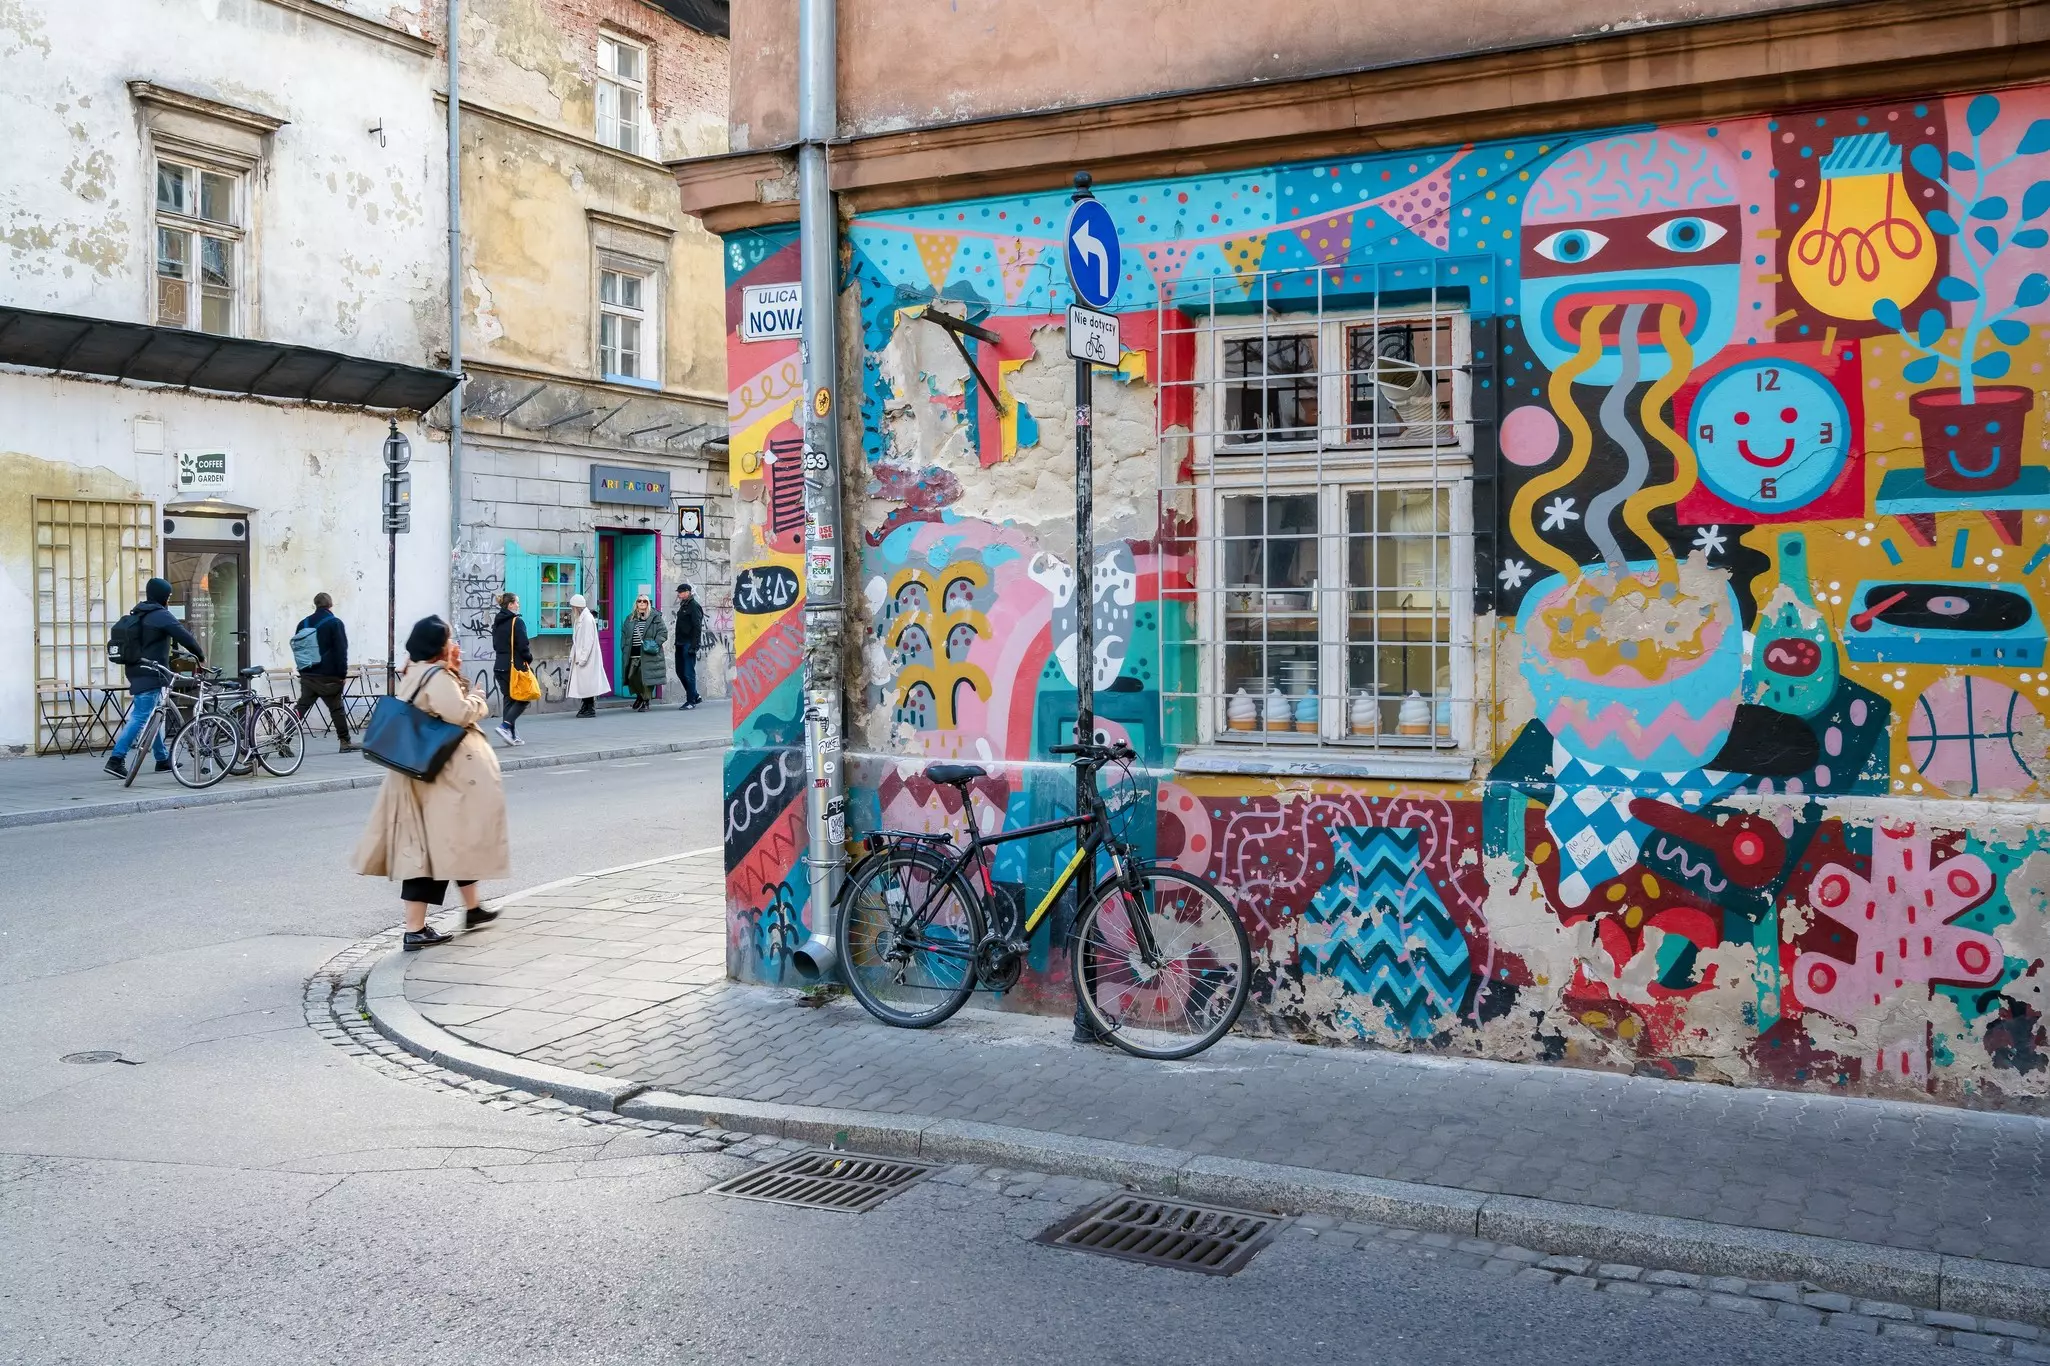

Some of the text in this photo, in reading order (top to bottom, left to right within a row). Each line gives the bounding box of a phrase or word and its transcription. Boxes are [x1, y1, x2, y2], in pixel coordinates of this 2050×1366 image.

[759, 289, 798, 304] ULICA
[1074, 311, 1117, 336] Nie dotyczy
[1756, 368, 1781, 392] 12
[1699, 424, 1715, 444] 9
[1819, 422, 1833, 444] 3
[198, 460, 224, 468] COFFEE
[601, 478, 665, 493] ART FACTORY
[1760, 477, 1777, 499] 6
